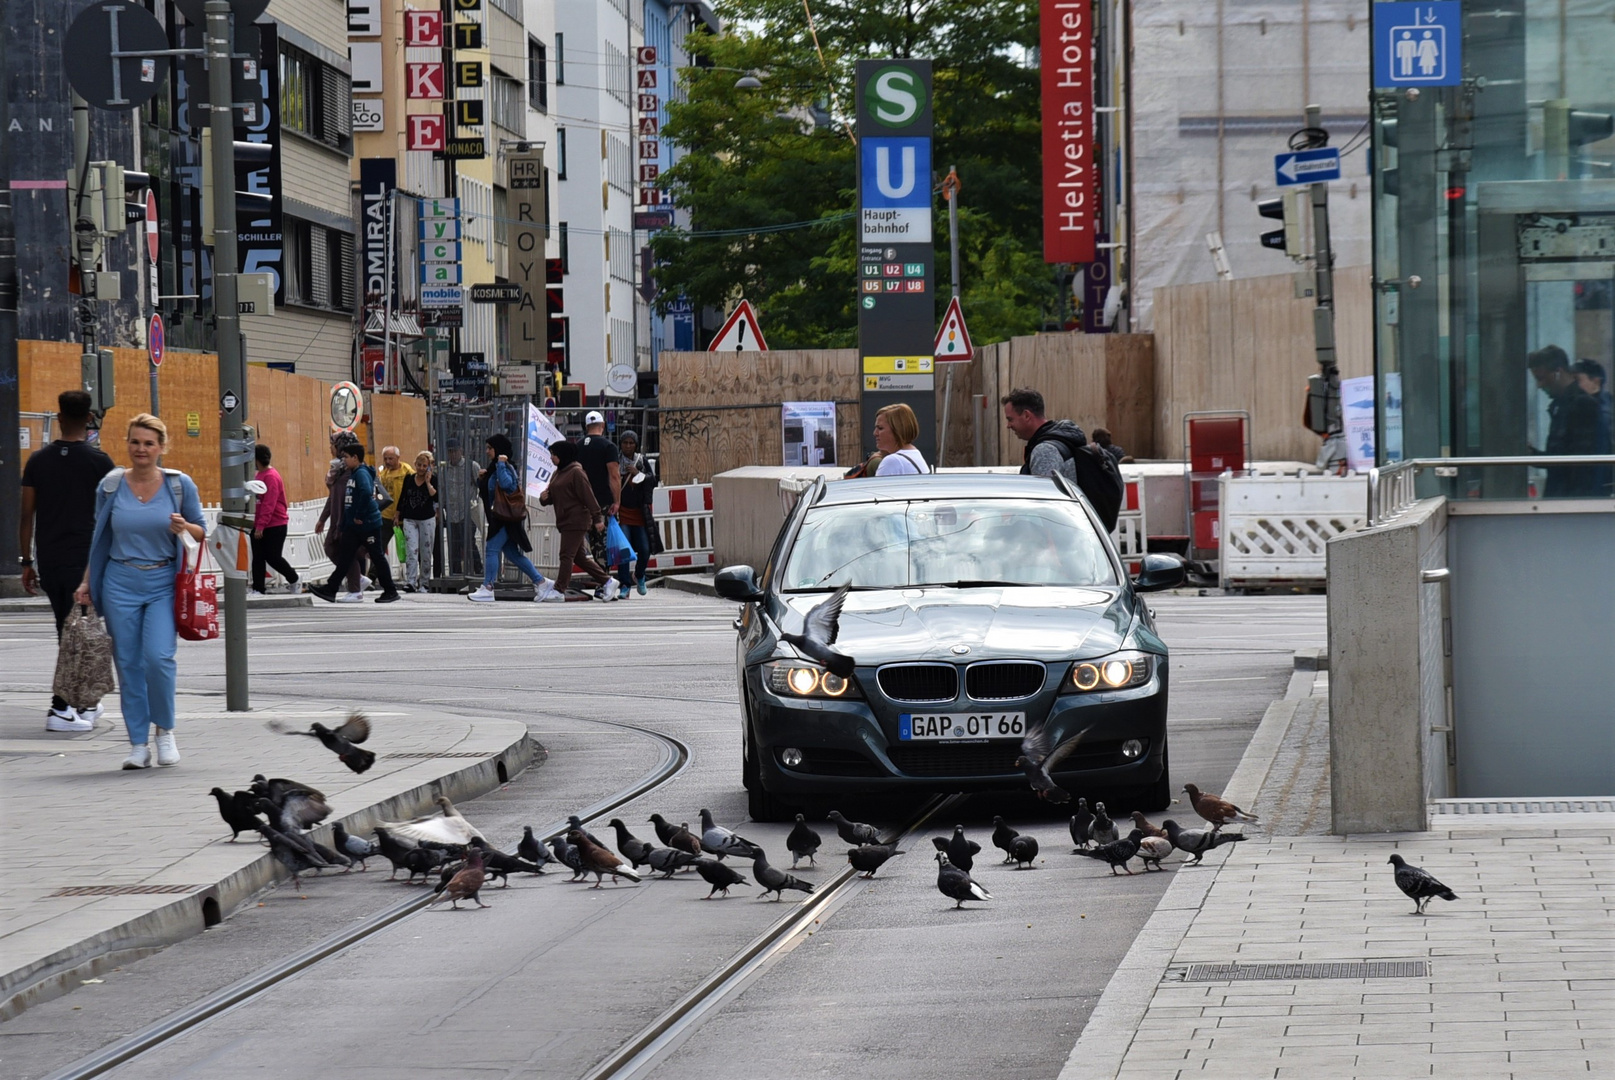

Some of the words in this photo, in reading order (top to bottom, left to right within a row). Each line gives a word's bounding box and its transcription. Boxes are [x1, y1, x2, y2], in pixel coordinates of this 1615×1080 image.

[1055, 3, 1083, 87] Hotel
[875, 71, 917, 122] S
[640, 48, 658, 204] CABARET
[445, 143, 483, 155] MONACO
[514, 163, 536, 176] HR
[875, 147, 916, 198] U
[1057, 101, 1084, 231] Helvetia
[864, 210, 901, 223] Haupt-
[864, 222, 909, 234] bahnhof
[237, 233, 282, 242] SCHILLER
[433, 200, 448, 280] Lyca
[861, 247, 882, 255] Eingang
[886, 249, 893, 259] F
[517, 203, 536, 341] ROYAL
[865, 266, 879, 275] U1
[886, 266, 900, 275] U2
[907, 265, 921, 275] U4
[865, 282, 879, 291] U5
[886, 282, 900, 291] U7
[907, 281, 921, 291] U8
[422, 288, 460, 298] mobile
[474, 288, 519, 298] KOSMETIK
[864, 297, 874, 309] S
[912, 716, 952, 736] GAP
[967, 715, 993, 735] OT
[998, 715, 1023, 735] 66
